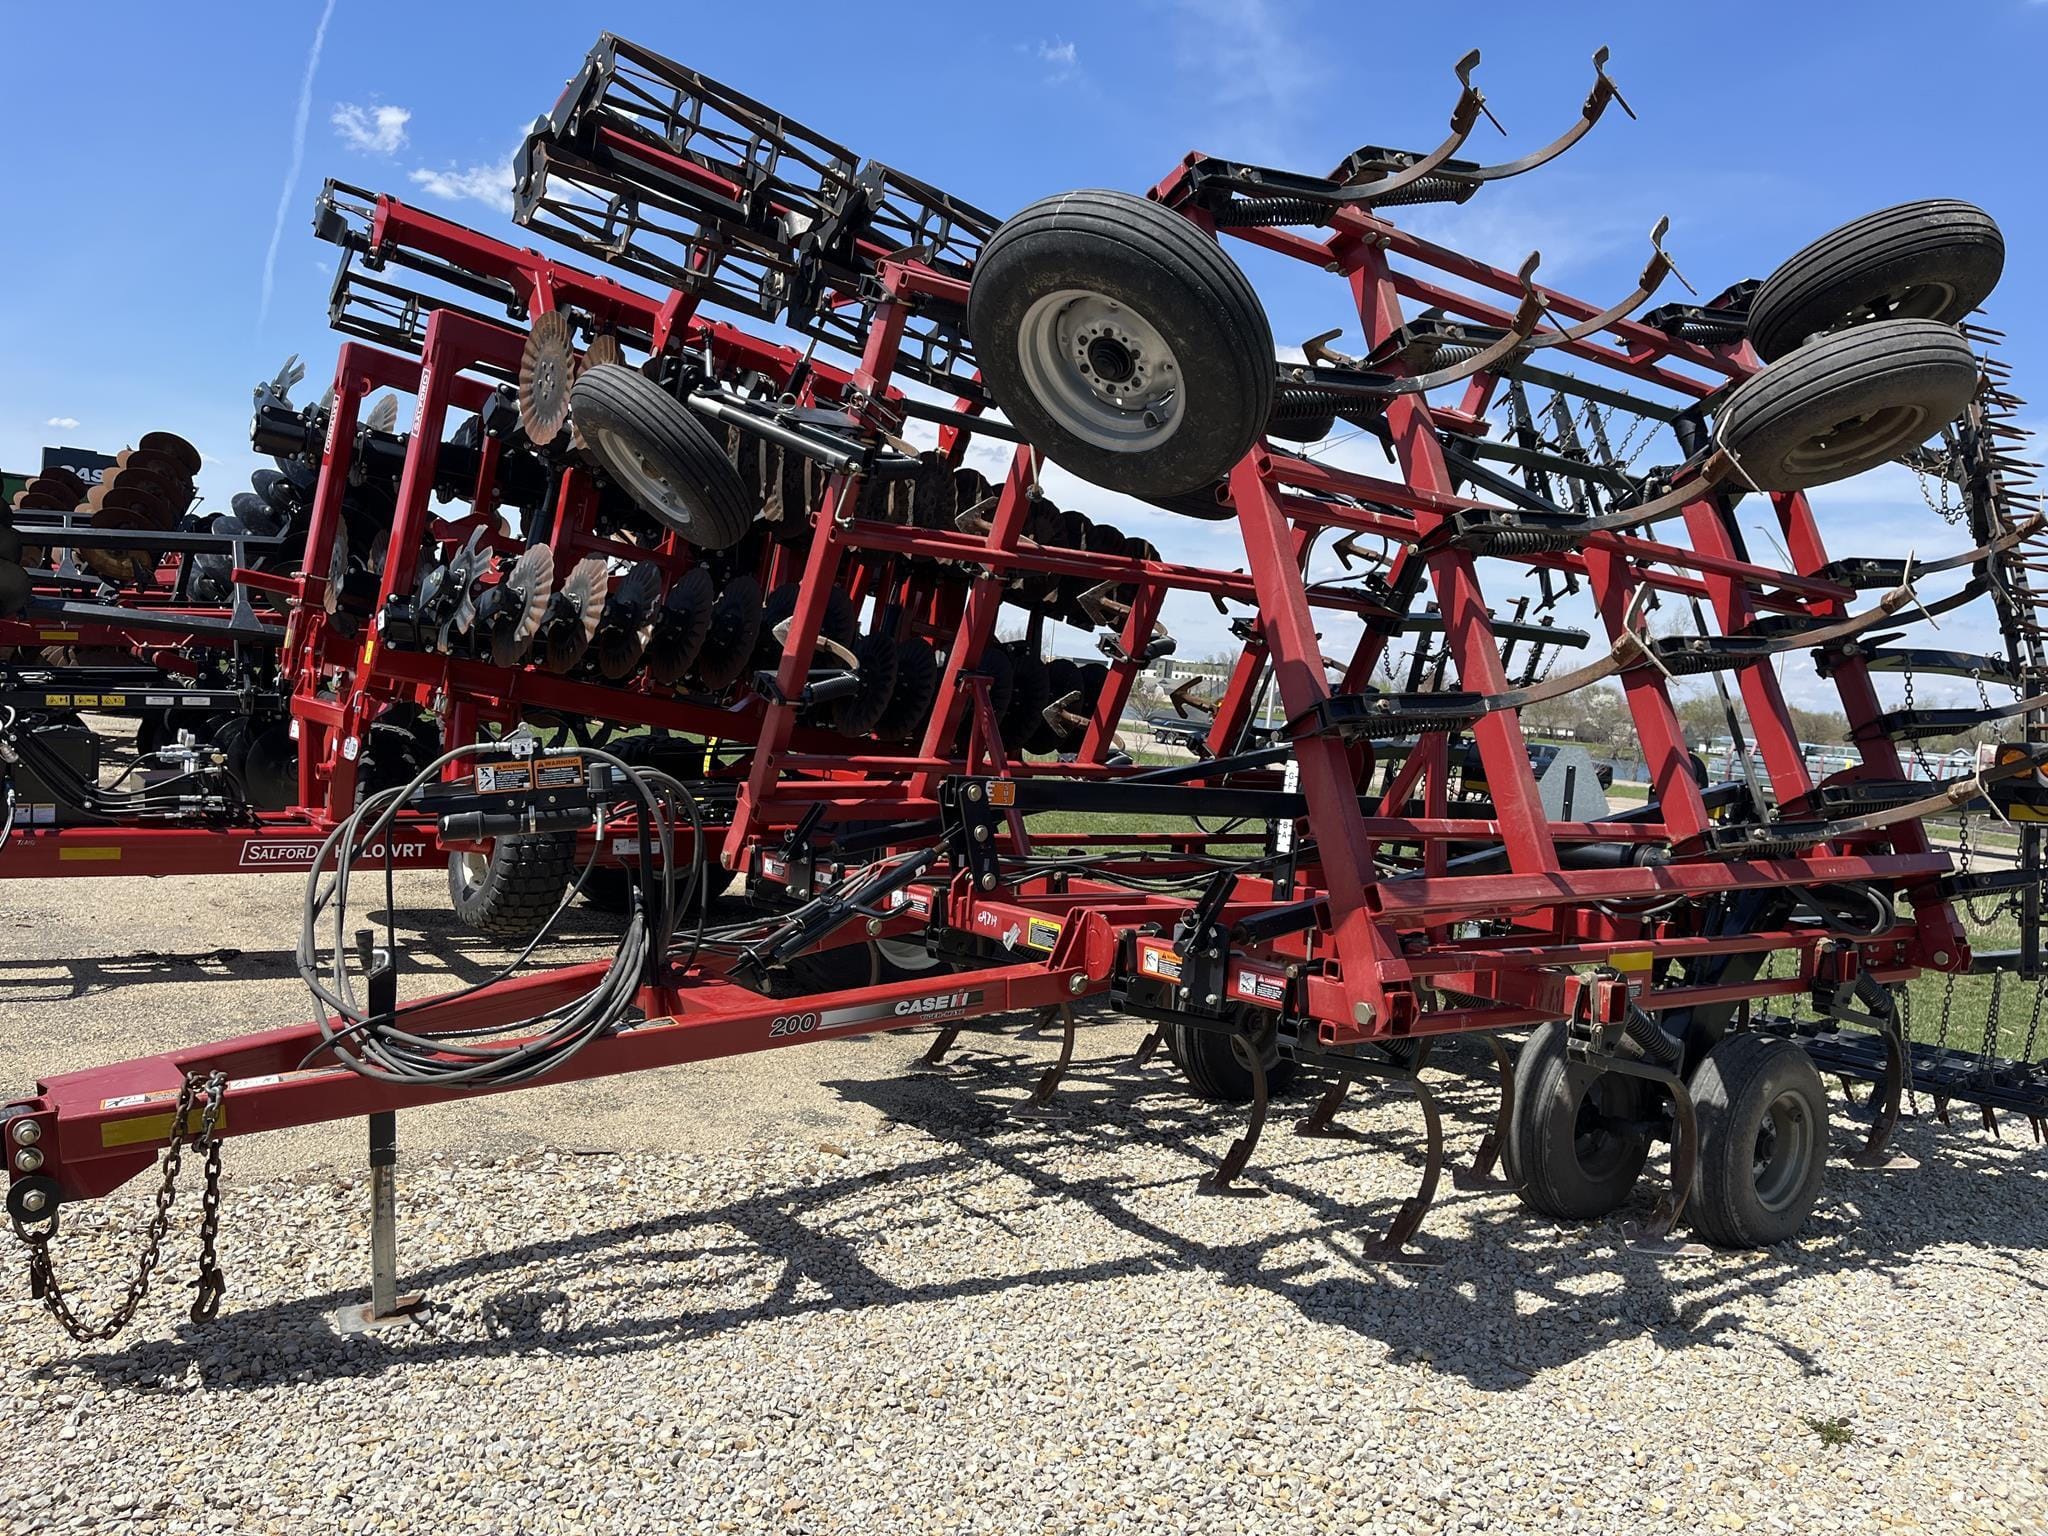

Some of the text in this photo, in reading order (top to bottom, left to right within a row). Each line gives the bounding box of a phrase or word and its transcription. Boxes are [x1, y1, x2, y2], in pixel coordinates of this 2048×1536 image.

[544, 759, 578, 767] WARNING
[1288, 772, 1295, 780] G
[248, 846, 319, 860] SALFORD
[391, 843, 426, 857] VRT
[894, 995, 950, 1016] CASE
[768, 1013, 817, 1038] 200
